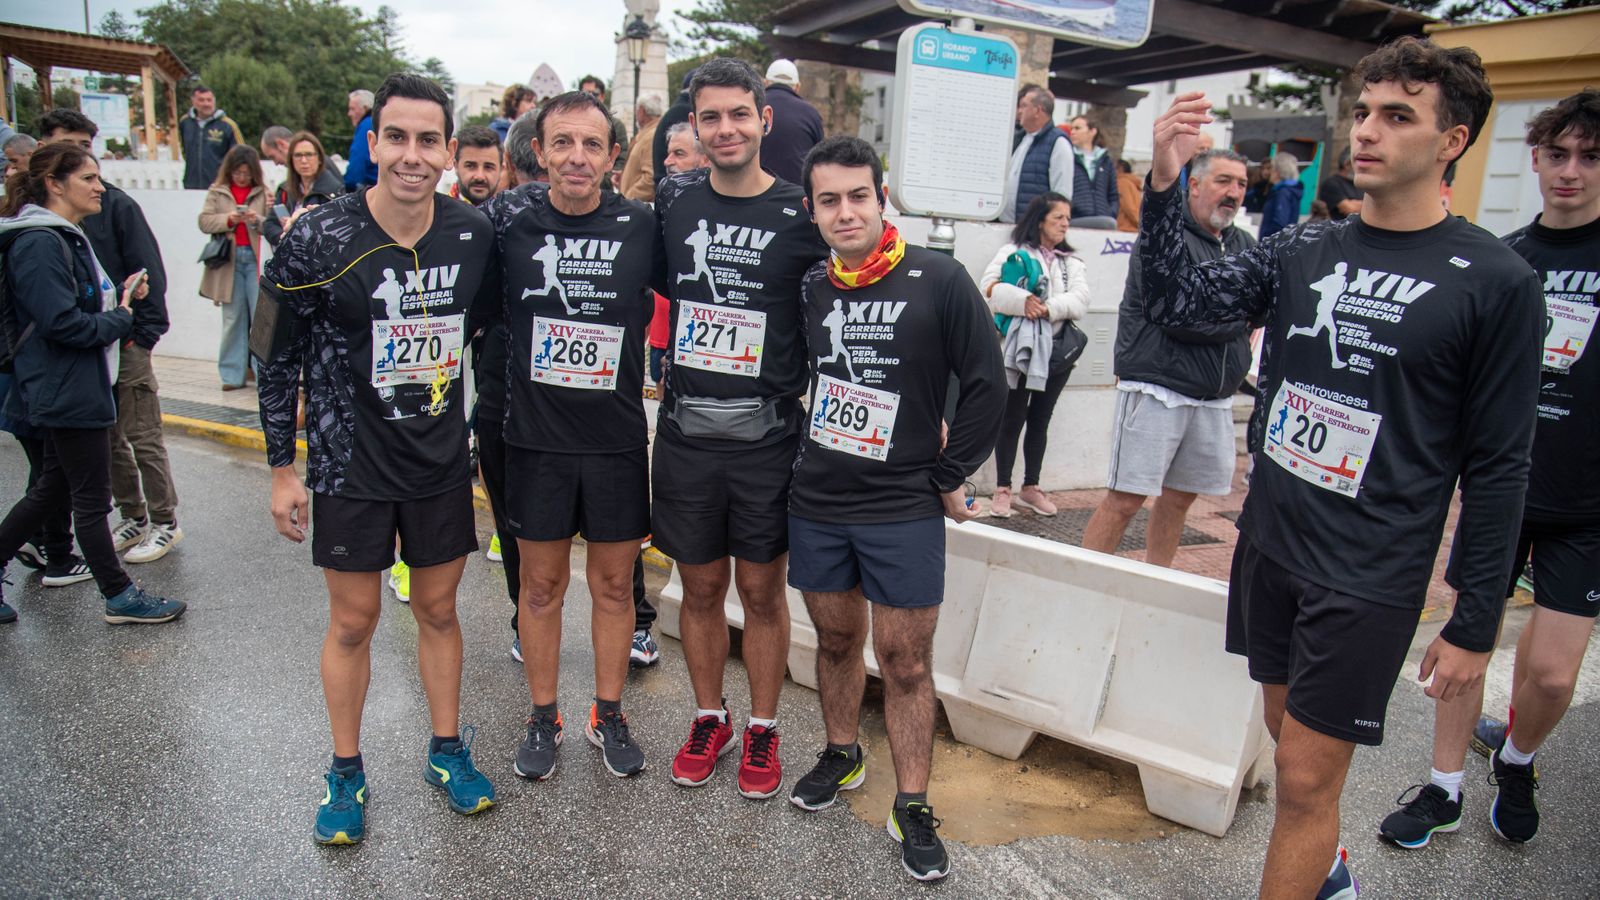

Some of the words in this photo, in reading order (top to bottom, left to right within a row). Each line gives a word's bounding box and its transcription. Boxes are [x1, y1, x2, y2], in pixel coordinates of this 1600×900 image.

[942, 42, 977, 55] HORARIOS
[942, 51, 970, 62] URBANO
[984, 49, 1013, 69] Tarifa
[713, 223, 776, 250] XIV
[562, 238, 623, 260] XIV
[708, 245, 759, 258] CARRERA
[558, 260, 609, 269] CARRERA
[707, 253, 761, 266] ESTRECHO
[558, 267, 613, 276] ESTRECHO
[715, 271, 742, 280] PEPE
[405, 264, 460, 293] XIV
[715, 277, 764, 290] SERRANO
[1544, 270, 1600, 292] XIV
[1347, 268, 1437, 304] XIV
[402, 290, 451, 303] CARRERA
[568, 290, 618, 298] SERRANO
[726, 290, 736, 300] 8
[1544, 293, 1590, 302] ARRERA
[402, 297, 454, 310] ESTRECHO
[580, 302, 590, 310] 8
[1338, 294, 1401, 314] CARRERA
[1547, 303, 1574, 313] ARRERA
[691, 306, 718, 321] XIV
[718, 311, 746, 320] CARRERA
[847, 302, 908, 323] XIV
[1335, 303, 1402, 324] ESTRECHO
[1554, 312, 1590, 324] ESTRECHO
[389, 324, 419, 337] XIV
[432, 326, 460, 335] ESTRECHO
[548, 324, 576, 338] XIV
[729, 320, 762, 329] ESTRECHO
[1336, 320, 1368, 331] MEMORIAL
[576, 327, 605, 336] CARRERA
[694, 322, 737, 351] 271
[1339, 326, 1372, 340] PEPE
[397, 336, 442, 364] 270
[552, 338, 598, 366] 268
[1337, 335, 1398, 356] SERRANO
[852, 356, 900, 365] SERRANO
[1348, 353, 1361, 366] 8
[862, 369, 872, 378] 8
[1349, 366, 1370, 376] TARIFA
[826, 382, 850, 399] XIV
[850, 388, 878, 400] CARRERA
[860, 398, 893, 411] ESTRECHO
[1285, 390, 1314, 414] XIV
[826, 398, 869, 432] 269
[1314, 403, 1350, 422] CARRERA
[1312, 411, 1326, 422] DEL
[1327, 418, 1370, 436] ESTRECHO
[1290, 414, 1328, 454] 20
[1354, 718, 1380, 728] KIPSTA
